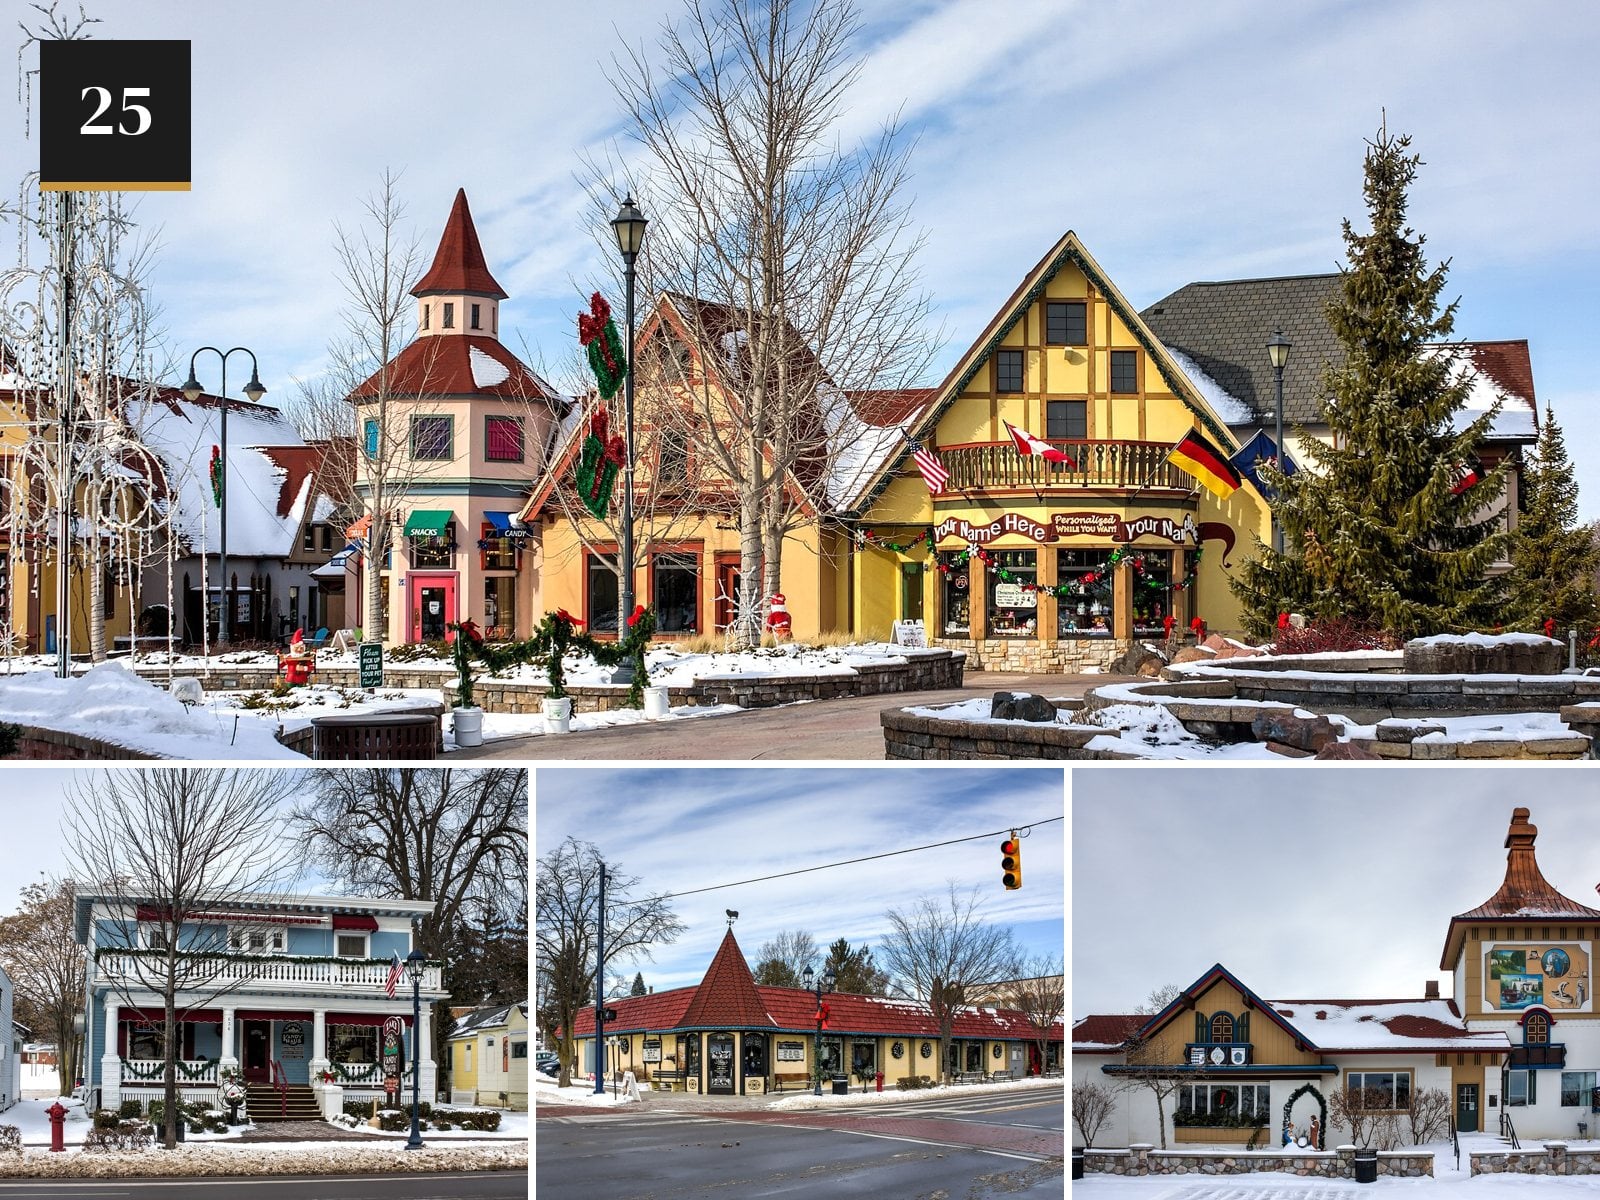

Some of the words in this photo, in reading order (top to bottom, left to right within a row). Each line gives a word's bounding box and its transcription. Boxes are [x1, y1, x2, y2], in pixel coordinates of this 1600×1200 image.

[1055, 515, 1117, 527] Personalized
[960, 521, 1001, 541] Name
[1005, 514, 1045, 541] Here
[1056, 525, 1079, 533] WHILE
[410, 528, 438, 536] SNACKS
[504, 529, 526, 537] CANDY
